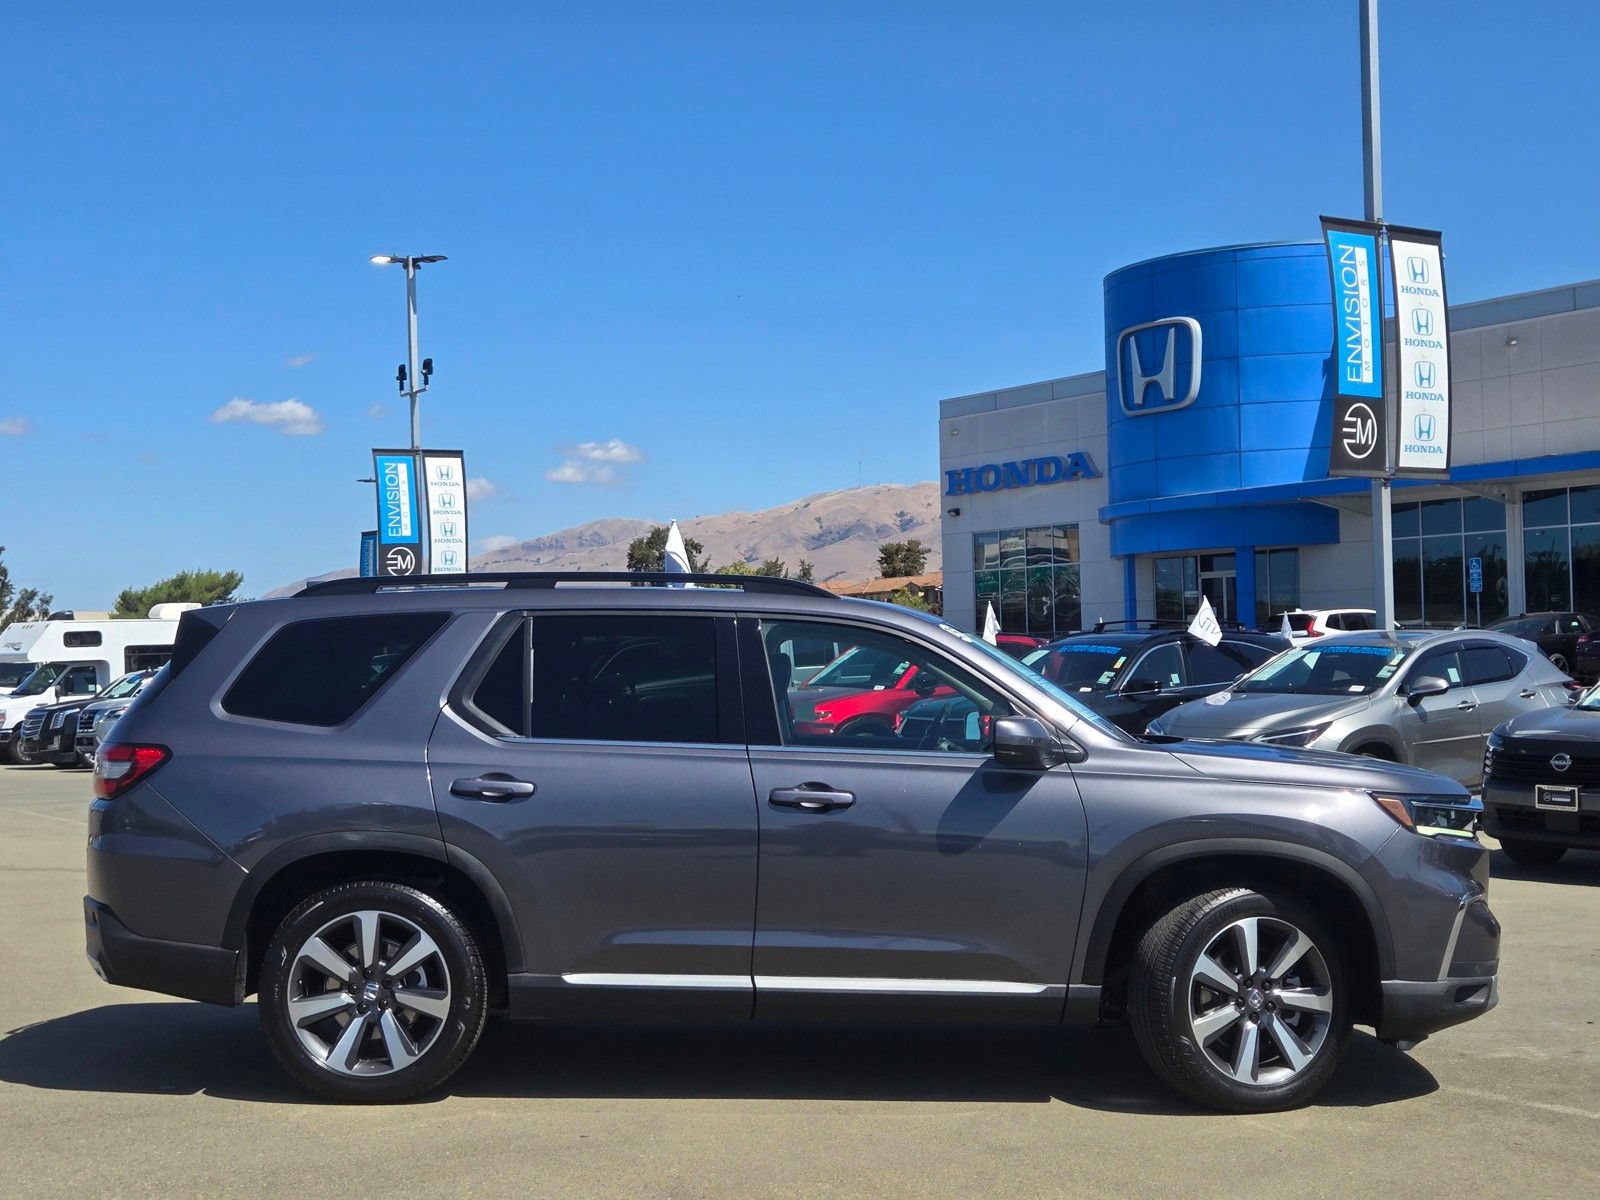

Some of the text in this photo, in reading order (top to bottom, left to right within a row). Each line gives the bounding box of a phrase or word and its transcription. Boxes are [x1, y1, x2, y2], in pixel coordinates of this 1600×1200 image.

[1401, 285, 1440, 297] HONDA
[1338, 244, 1362, 383] ENVISION
[1359, 259, 1371, 372] MOTORS
[1404, 338, 1443, 349] HONDA
[1406, 391, 1444, 402] HONDA
[1404, 444, 1443, 454] HONDA
[945, 452, 1103, 496] HONDA
[384, 462, 402, 537] ENVISION
